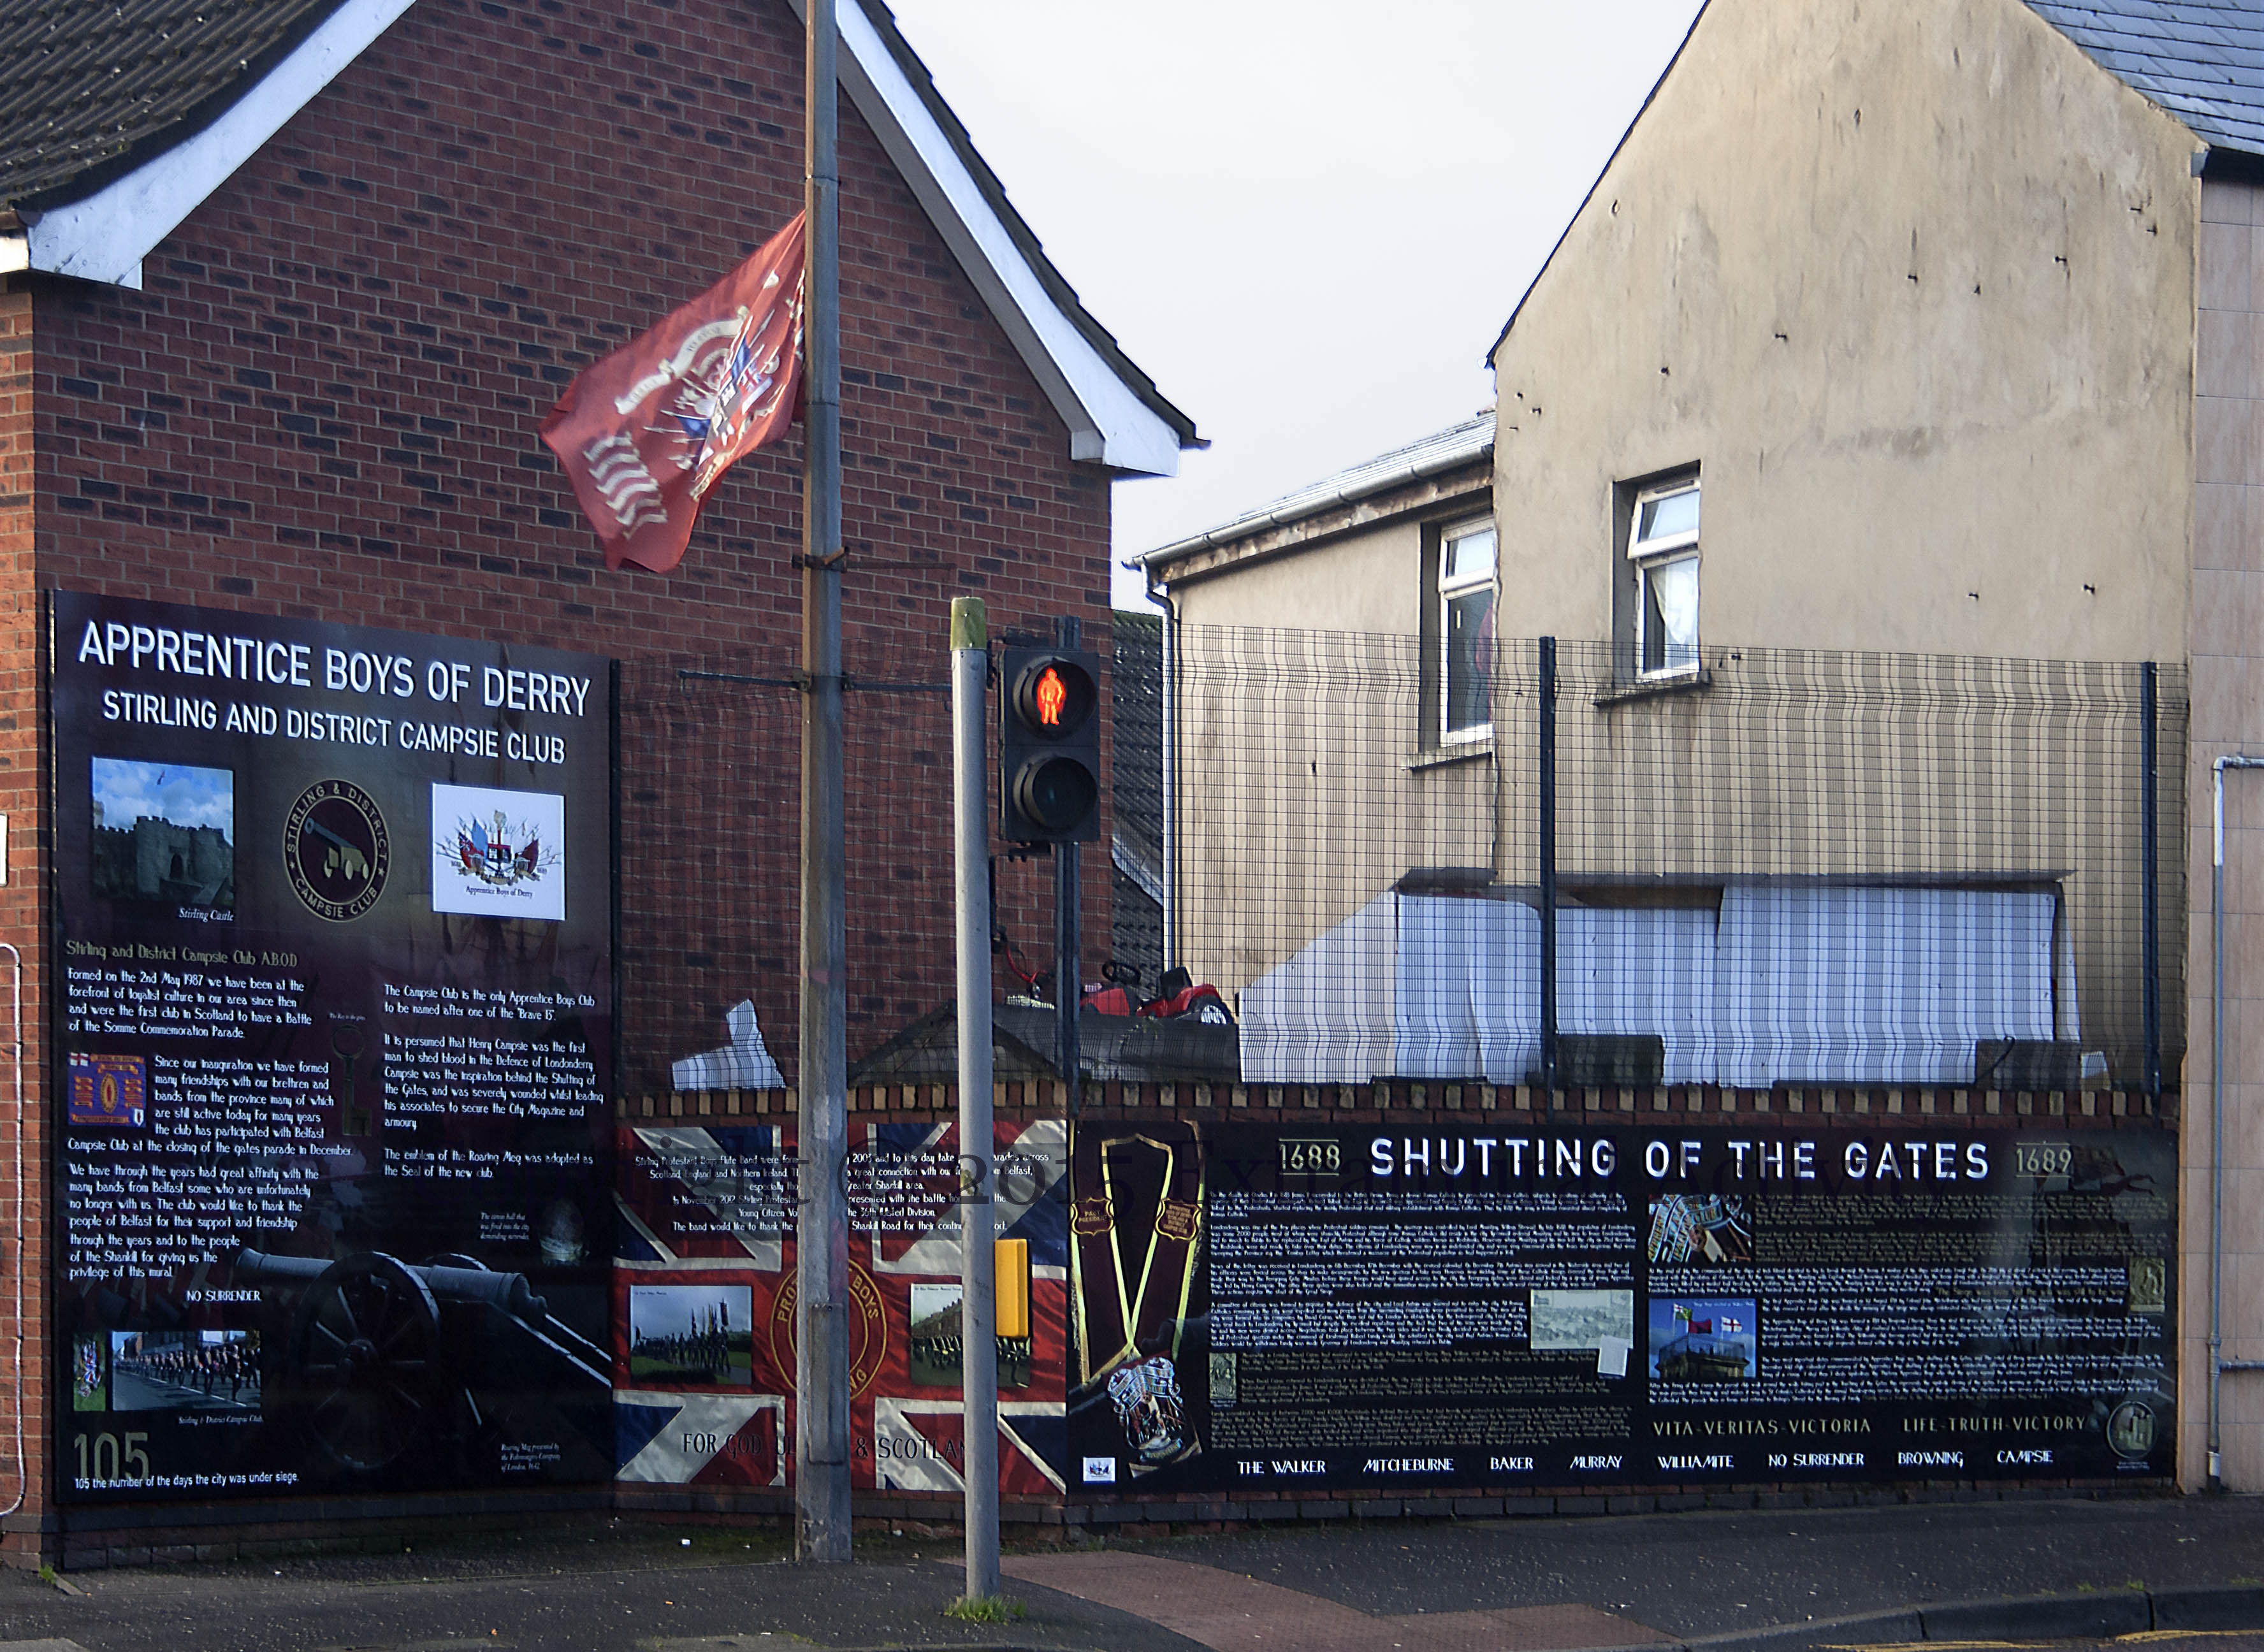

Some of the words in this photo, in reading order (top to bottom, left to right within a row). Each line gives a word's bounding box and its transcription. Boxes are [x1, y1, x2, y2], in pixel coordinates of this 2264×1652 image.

[79, 621, 310, 686] APPRENTICE
[326, 648, 414, 697] BOYS
[428, 661, 470, 702] OF
[484, 665, 590, 716] DERRY
[104, 690, 215, 729] STIRLING
[226, 704, 276, 735] AND
[287, 709, 391, 746] DISTRICT
[400, 721, 498, 757] CAMPSIE
[507, 732, 564, 764] CLUB
[287, 785, 326, 853] STIRLING
[333, 783, 340, 795] &
[347, 788, 388, 861] DISTRICT
[296, 878, 344, 918] CAMPSIE
[350, 887, 377, 915] CLUB
[466, 886, 495, 897] Apprentice
[496, 887, 509, 897] Boys
[518, 889, 533, 899] Derry
[178, 907, 209, 923] Stirling
[210, 909, 235, 922] Castle
[66, 940, 106, 960] Stirling
[112, 944, 133, 957] and
[138, 944, 175, 960] District
[182, 947, 228, 966] Campsie
[233, 950, 256, 965] Club
[68, 967, 101, 981] Formed
[105, 973, 116, 982] on
[120, 970, 135, 982] the
[140, 971, 156, 983] 2nd
[161, 973, 179, 988] May
[184, 974, 203, 985] 1987
[207, 979, 221, 987] we
[225, 976, 245, 989] have
[249, 978, 272, 990] been
[275, 980, 284, 990] at
[290, 980, 303, 991] the
[68, 984, 108, 998] forefront
[113, 987, 124, 999] of
[128, 988, 159, 1003] loyalist
[164, 990, 192, 1003] culture
[196, 993, 204, 1002] in
[208, 996, 221, 1004] our
[226, 996, 246, 1004] area
[250, 997, 273, 1006] since
[277, 996, 296, 1008] then
[384, 983, 400, 996] The
[403, 985, 437, 1000] Campsie
[441, 987, 458, 999] Club
[462, 990, 469, 999] is
[474, 989, 486, 1001] the
[490, 990, 505, 1004] only
[509, 991, 553, 1006] Apprentice
[556, 994, 575, 1008] Boys
[578, 994, 595, 1006] Club
[69, 1003, 86, 1014] and
[90, 1006, 114, 1015] were
[119, 1004, 133, 1016] the
[138, 1005, 156, 1017] first
[161, 1006, 178, 1018] club
[183, 1010, 190, 1018] in
[194, 1008, 233, 1021] Scotland
[237, 1010, 247, 1022] to
[250, 1011, 271, 1022] have
[286, 1012, 310, 1025] Battle
[384, 1001, 394, 1013] to
[397, 1002, 409, 1013] be
[413, 1004, 439, 1015] named
[444, 1004, 463, 1016] after
[468, 1008, 483, 1017] one
[487, 1006, 496, 1017] of
[501, 1007, 513, 1018] the
[68, 1020, 79, 1031] of
[85, 1020, 99, 1032] the
[104, 1020, 136, 1033] Somme
[140, 1022, 208, 1036] Commemoration
[893, 1153, 901, 1163] to
[921, 1153, 935, 1164] day
[938, 1152, 954, 1162] take
[1279, 1143, 1341, 1171] 1688
[1371, 1138, 1613, 1177] SHUTTING
[1646, 1141, 1701, 1178] OF
[1728, 1141, 1815, 1179] THE
[1845, 1142, 1988, 1180] GATES
[2015, 1147, 2073, 1174] 1689
[739, 1208, 759, 1219] Young
[762, 1208, 785, 1217] Citizen
[882, 1221, 901, 1230] Road
[904, 1221, 914, 1230] for
[918, 1221, 934, 1230] their
[673, 1222, 686, 1231] The
[689, 1222, 707, 1231] band
[710, 1222, 730, 1231] would
[749, 1222, 756, 1231] to
[759, 1221, 778, 1230] thank
[782, 1221, 794, 1230] the
[186, 1291, 201, 1301] NO
[205, 1290, 259, 1301] SURRENDER
[852, 1274, 880, 1320] BOYS
[74, 1431, 149, 1479] 105
[683, 1433, 717, 1454] FOR
[725, 1434, 762, 1460] GOD
[856, 1437, 868, 1458] &
[878, 1437, 966, 1459] SCOTLA
[1237, 1461, 1264, 1474] THE
[1272, 1460, 1325, 1474] WALKER
[1491, 1457, 1533, 1470] BAKER
[1570, 1455, 1622, 1468] MURRAY
[1769, 1454, 1787, 1467] NO
[1793, 1453, 1864, 1466] SURRENDER
[1898, 1452, 1963, 1468] BROWNING
[1997, 1450, 2052, 1464] CAMPSIE
[75, 1475, 89, 1490] 105
[92, 1473, 106, 1488] the
[109, 1474, 143, 1488] number
[145, 1475, 154, 1486] of
[157, 1476, 170, 1486] the
[173, 1475, 192, 1488] days
[196, 1475, 208, 1485] the
[212, 1474, 226, 1487] city
[229, 1475, 246, 1484] was
[249, 1472, 273, 1482] under
